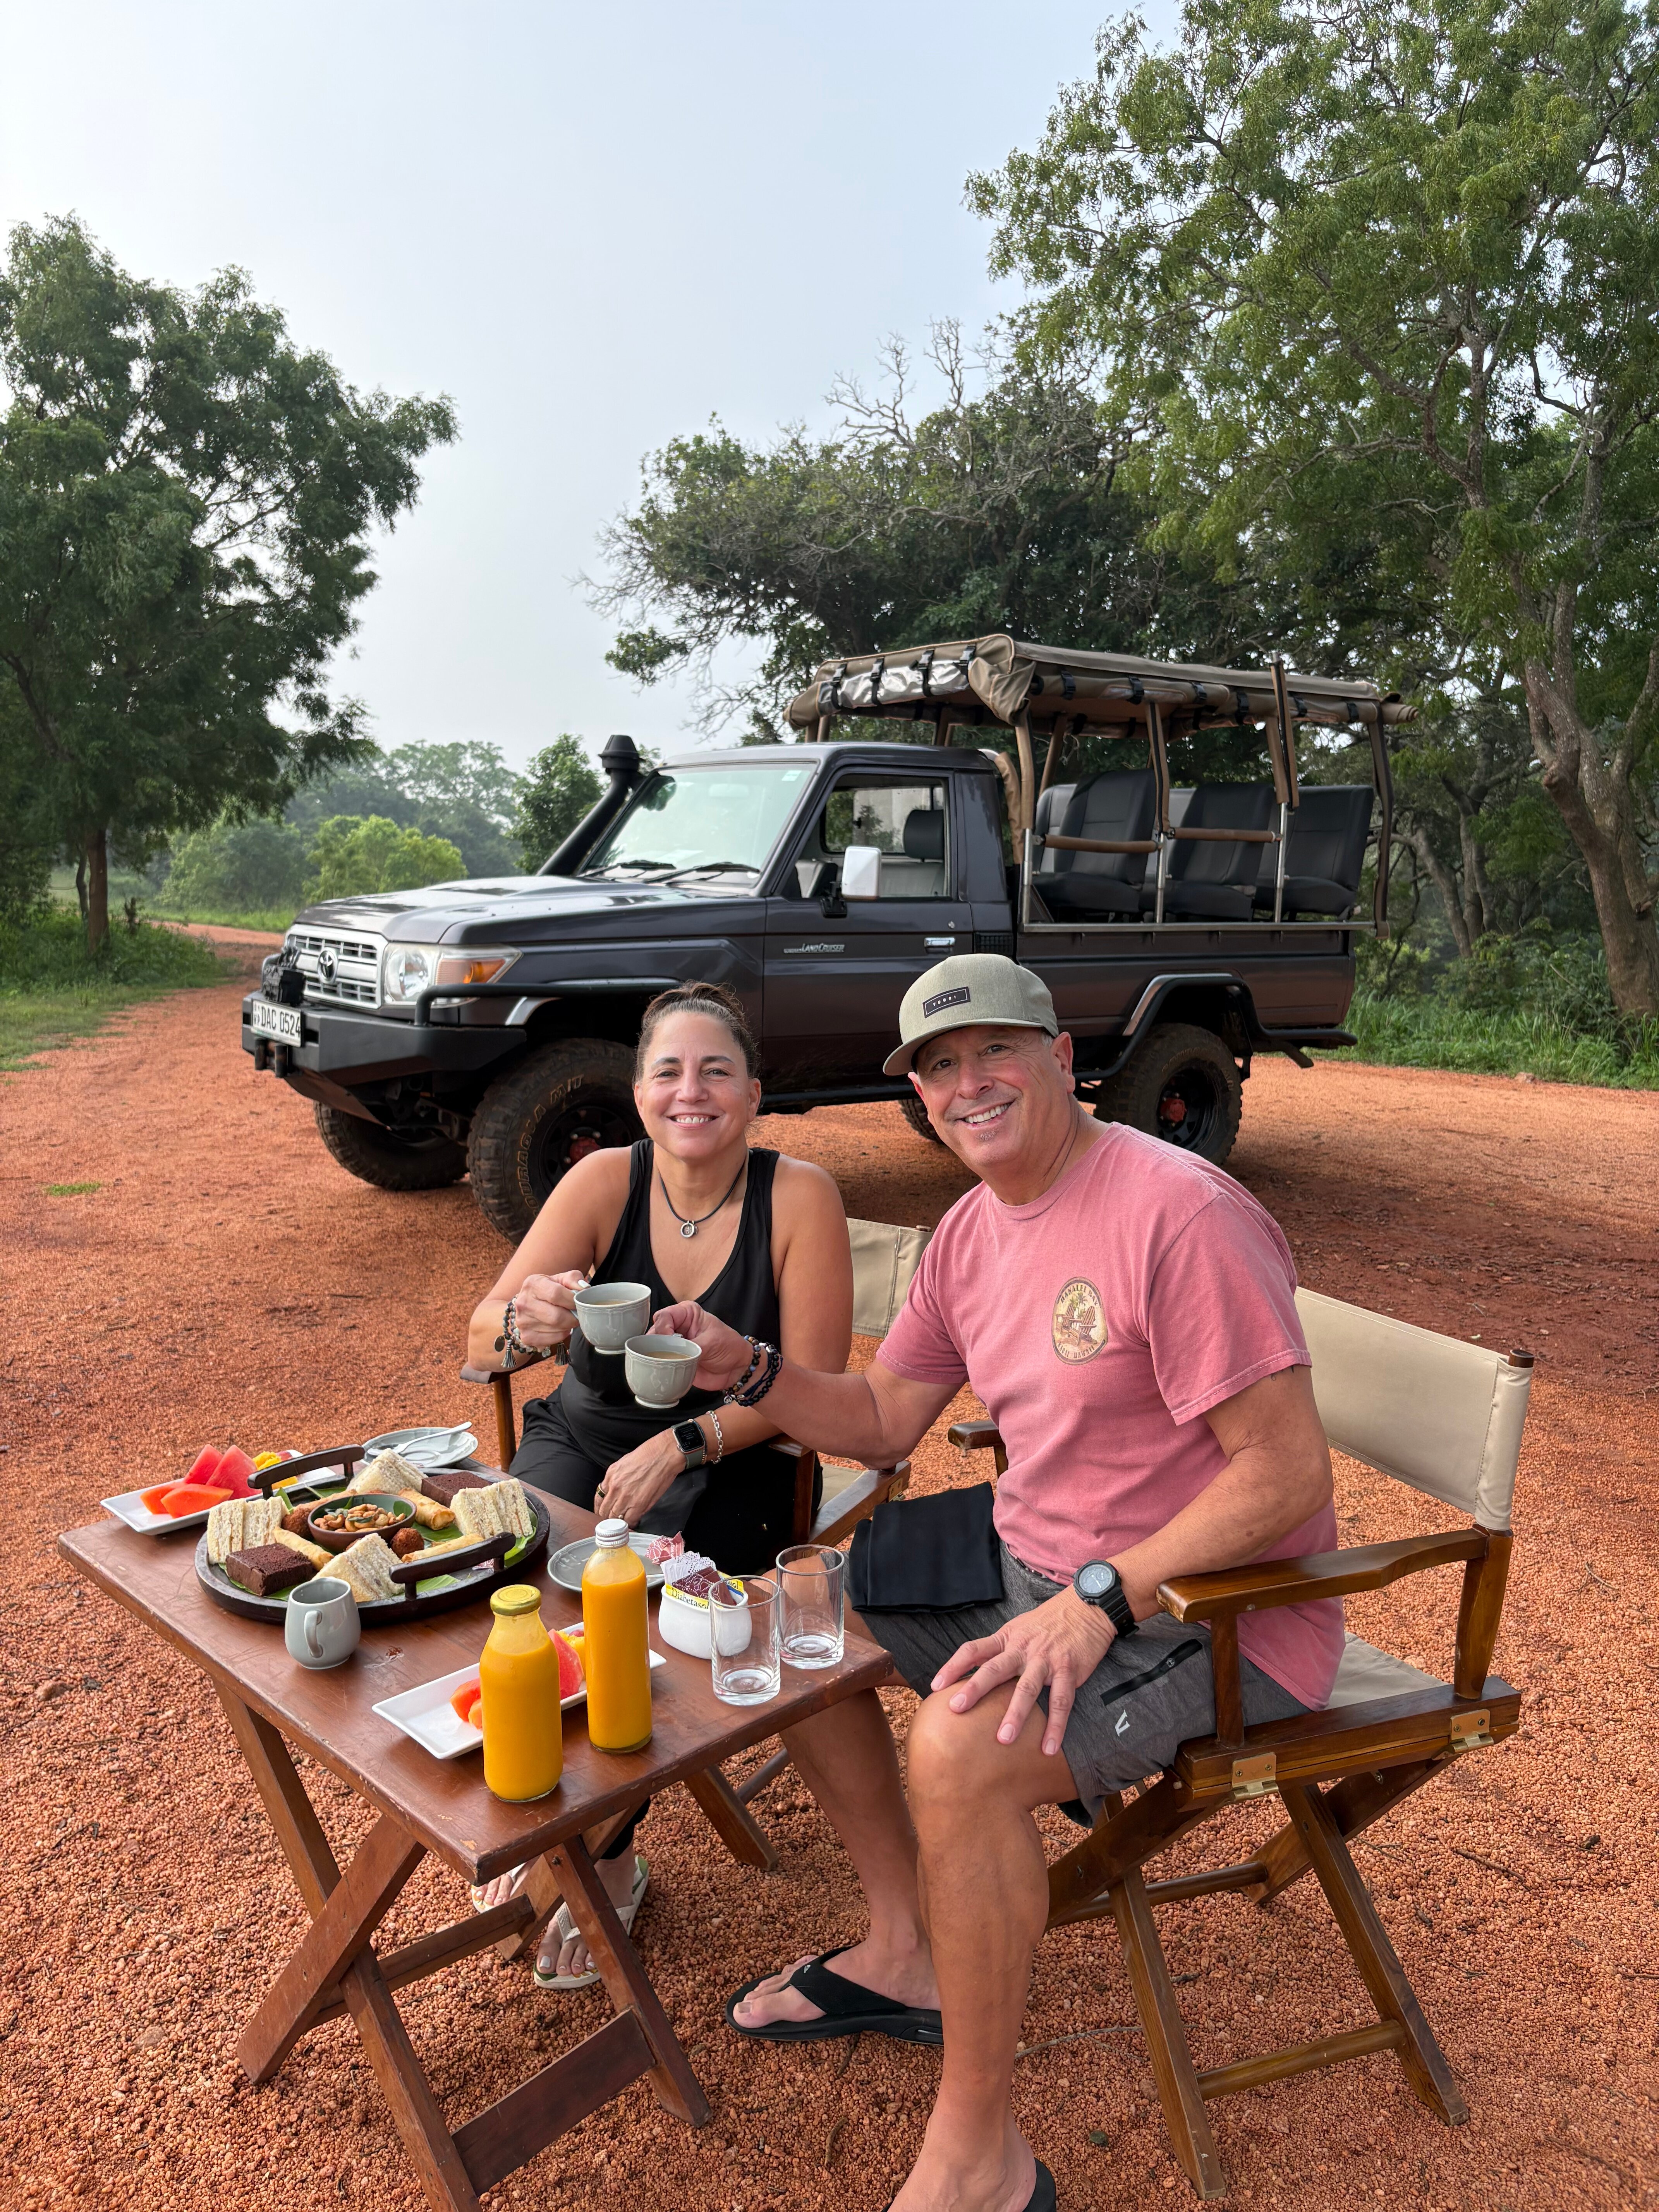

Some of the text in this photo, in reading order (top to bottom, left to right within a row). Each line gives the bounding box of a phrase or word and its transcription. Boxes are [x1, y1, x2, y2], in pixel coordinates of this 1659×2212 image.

[933, 995, 956, 1006] VUORI
[261, 1006, 301, 1037] DAC 0524
[1061, 1285, 1097, 1306] HANALEI BAY
[1074, 1345, 1094, 1358] HAWAII
[672, 1587, 709, 1609] Diabetasol
